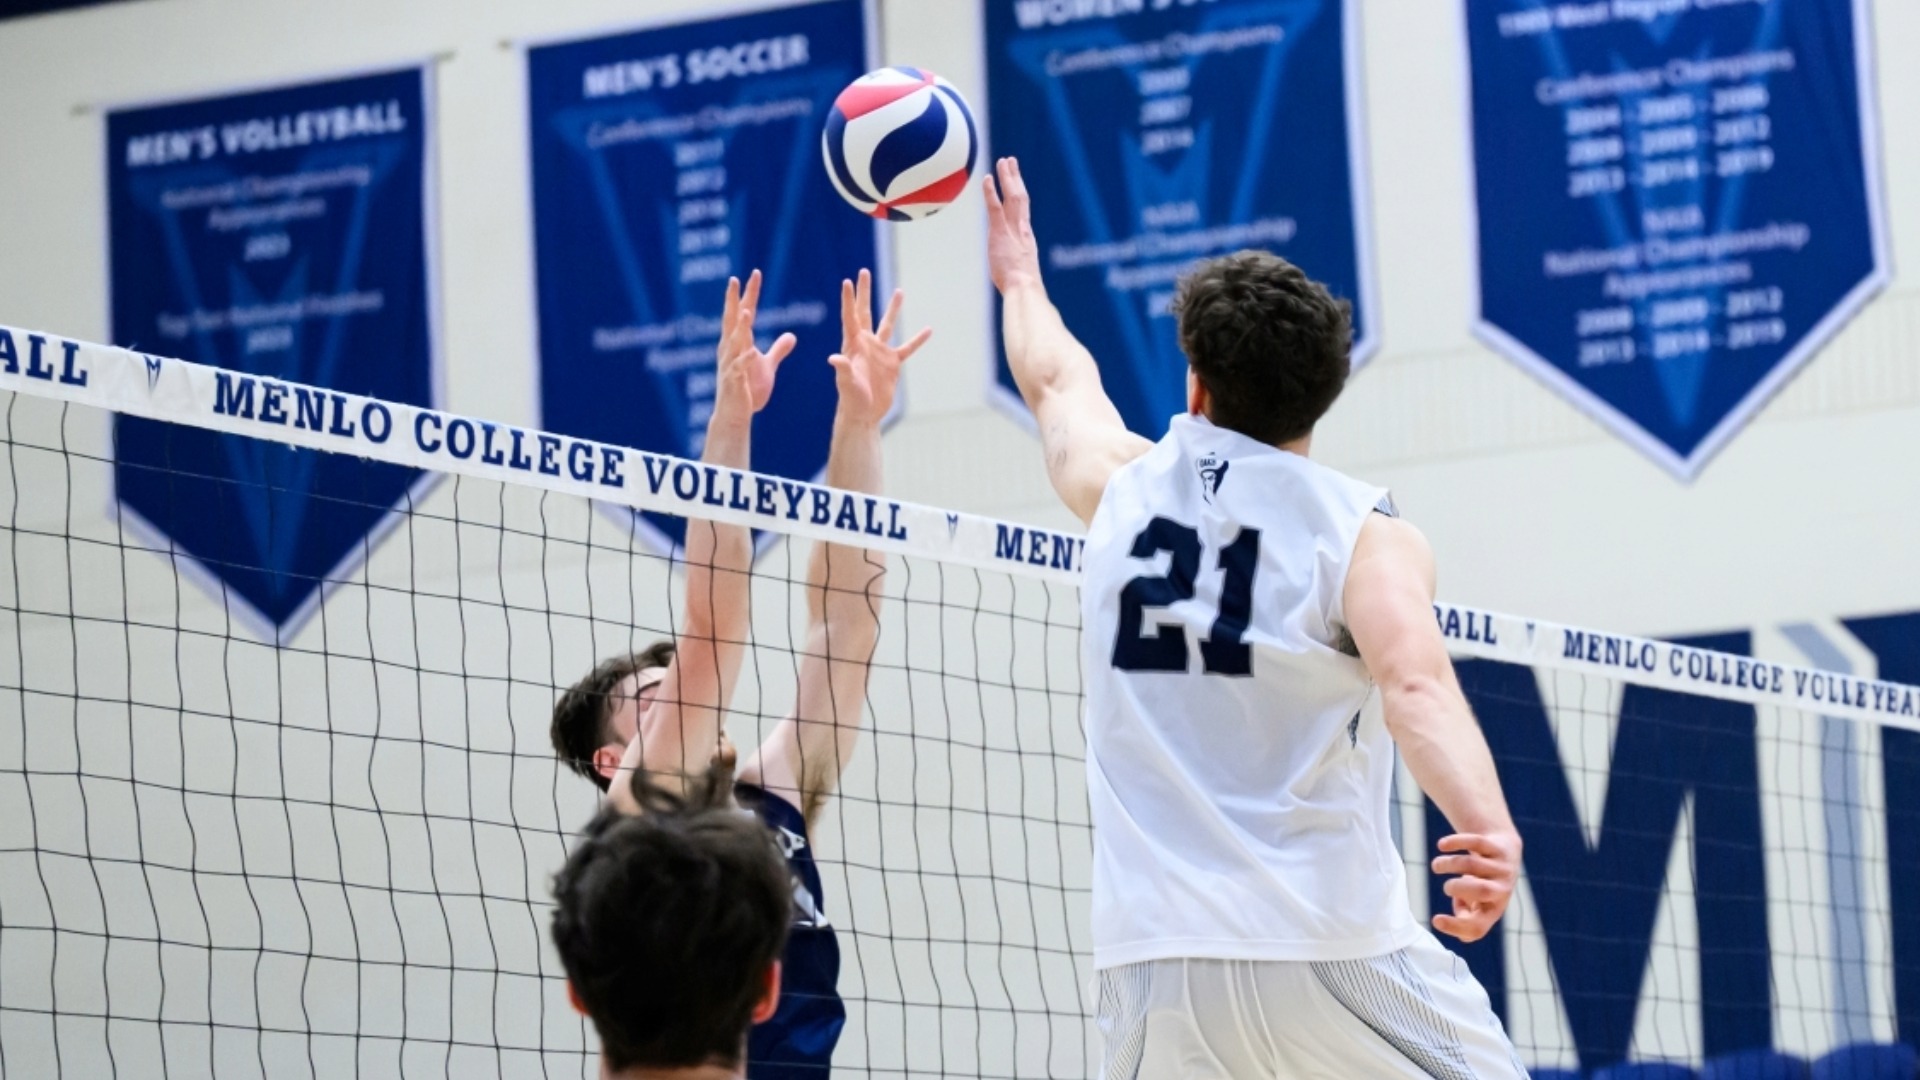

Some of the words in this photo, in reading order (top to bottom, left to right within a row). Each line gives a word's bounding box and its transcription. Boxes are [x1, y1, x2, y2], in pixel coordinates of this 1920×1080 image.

[585, 56, 679, 96] MEN'S
[687, 36, 808, 82] SOCCER
[1537, 71, 1661, 103] Conference
[1667, 50, 1793, 84] Champions
[128, 127, 215, 165] MEN'S
[222, 101, 404, 152] VOLLEYBALL
[1546, 249, 1636, 275] National
[1646, 224, 1808, 261] Championship
[213, 371, 393, 444] MENLO
[414, 412, 625, 488] COLLEGE
[643, 455, 908, 541] VOLLEYBALL
[1111, 513, 1263, 677] 21
[1563, 629, 1657, 672] MENLO
[1669, 648, 1784, 694] COLLEGE
[1793, 669, 1920, 718] VOLLEYBA
